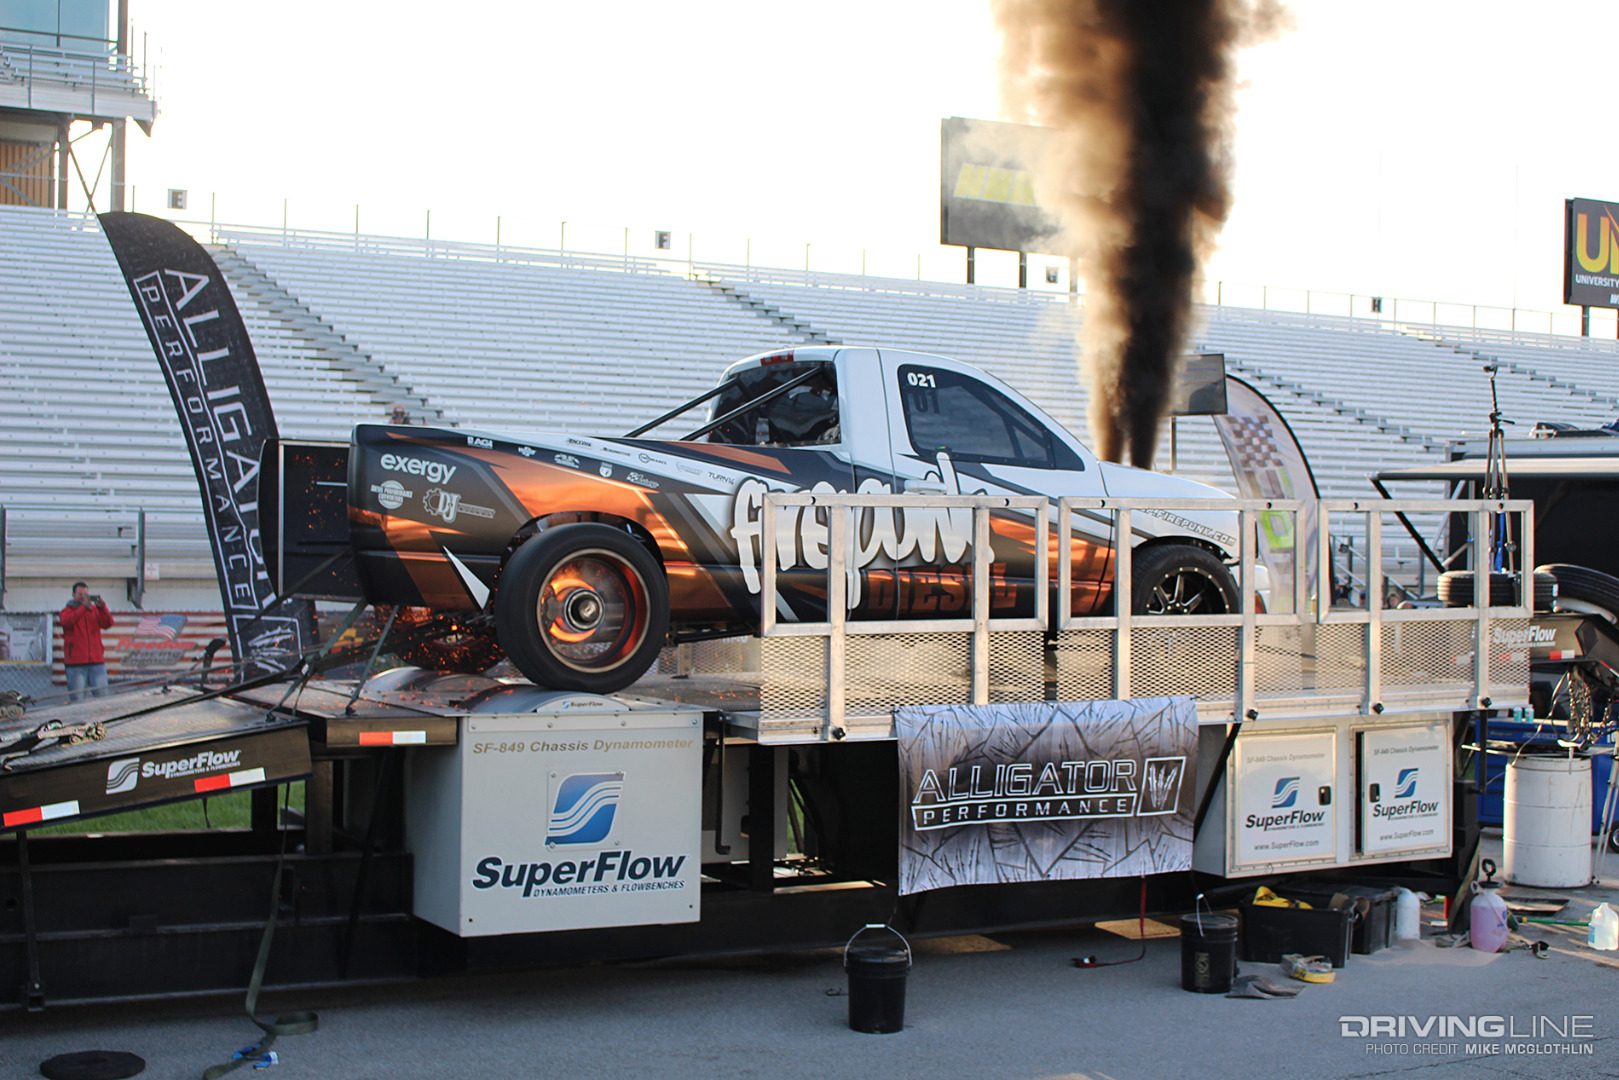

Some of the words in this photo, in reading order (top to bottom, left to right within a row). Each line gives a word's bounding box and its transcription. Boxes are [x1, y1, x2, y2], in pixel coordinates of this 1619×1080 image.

[953, 163, 1041, 207] NHR
[172, 191, 184, 208] E
[658, 232, 668, 248] F
[1575, 273, 1619, 288] UNIVERSITY
[1372, 298, 1381, 312] H
[907, 372, 936, 388] 021
[140, 284, 251, 599] PERFORMANCE
[380, 453, 457, 484] exergy
[867, 562, 1017, 611] DIESL
[116, 637, 195, 650] Freedom
[473, 742, 525, 754] SF-849
[530, 740, 589, 752] Chassis
[593, 738, 694, 752] Dynamometer
[141, 750, 240, 779] SuperFlow
[913, 759, 1137, 803] ALLIGATOR
[922, 798, 1128, 825] PERFORMANCE
[1373, 800, 1439, 820] SuperFlow
[1245, 810, 1325, 831] SuperFlow
[1380, 829, 1434, 841] www.SuperFlow.com
[1254, 839, 1319, 851] www.SuperFlow.com
[473, 850, 686, 898] SuperFlow
[533, 885, 609, 897] DYNAMOMETERS
[611, 884, 618, 893] &
[621, 881, 685, 893] FLOWBENCHES
